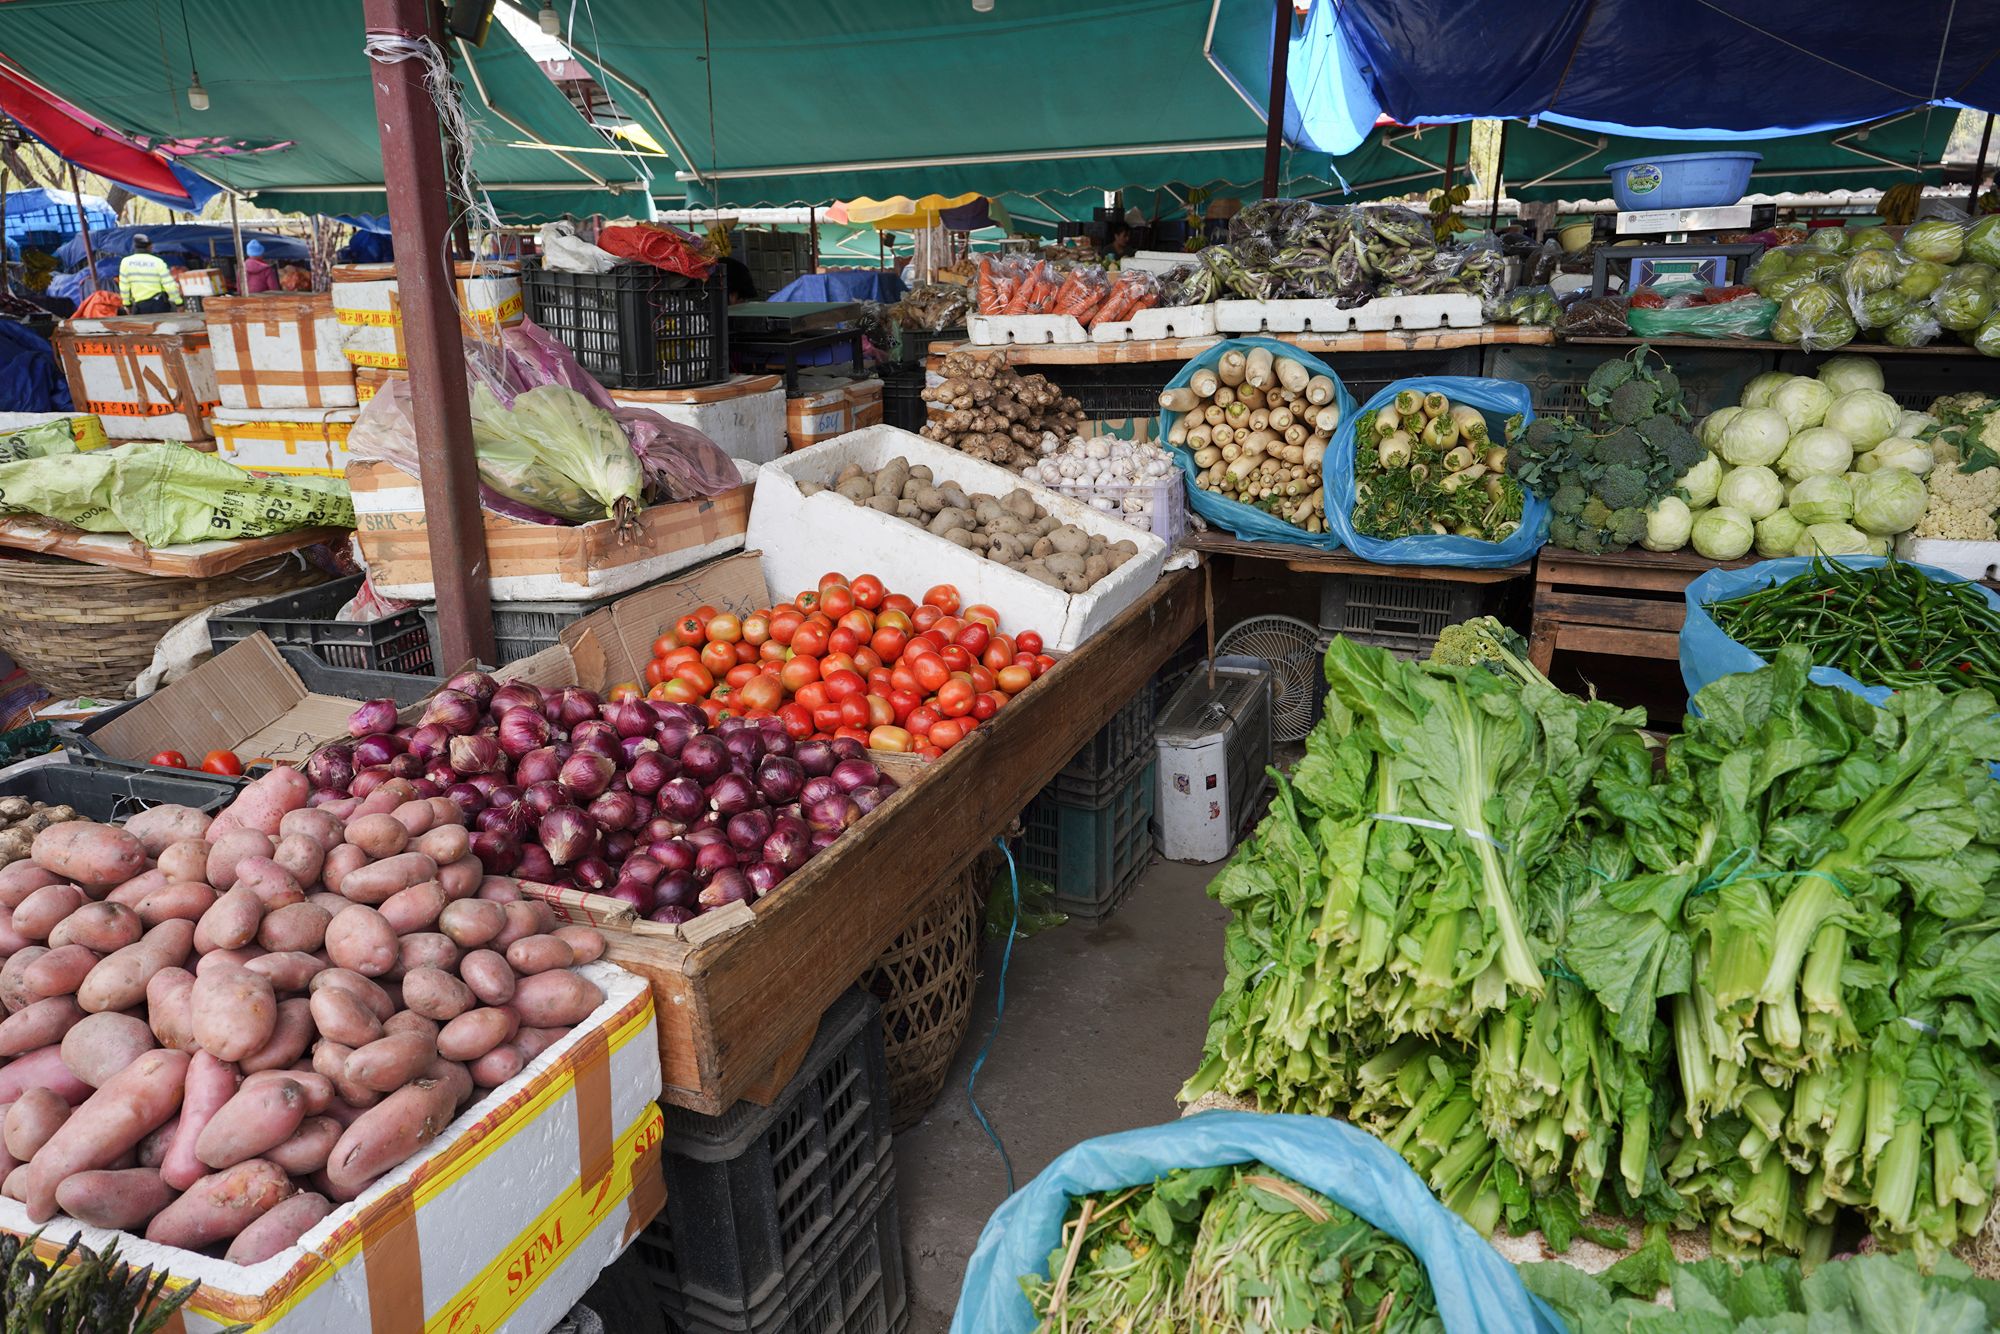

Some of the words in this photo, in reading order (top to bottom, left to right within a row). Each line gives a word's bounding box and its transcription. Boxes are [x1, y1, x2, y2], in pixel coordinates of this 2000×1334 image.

[128, 260, 155, 268] POLICE
[266, 498, 292, 521] 26
[365, 512, 397, 531] SRK
[506, 1216, 565, 1297] SFM
